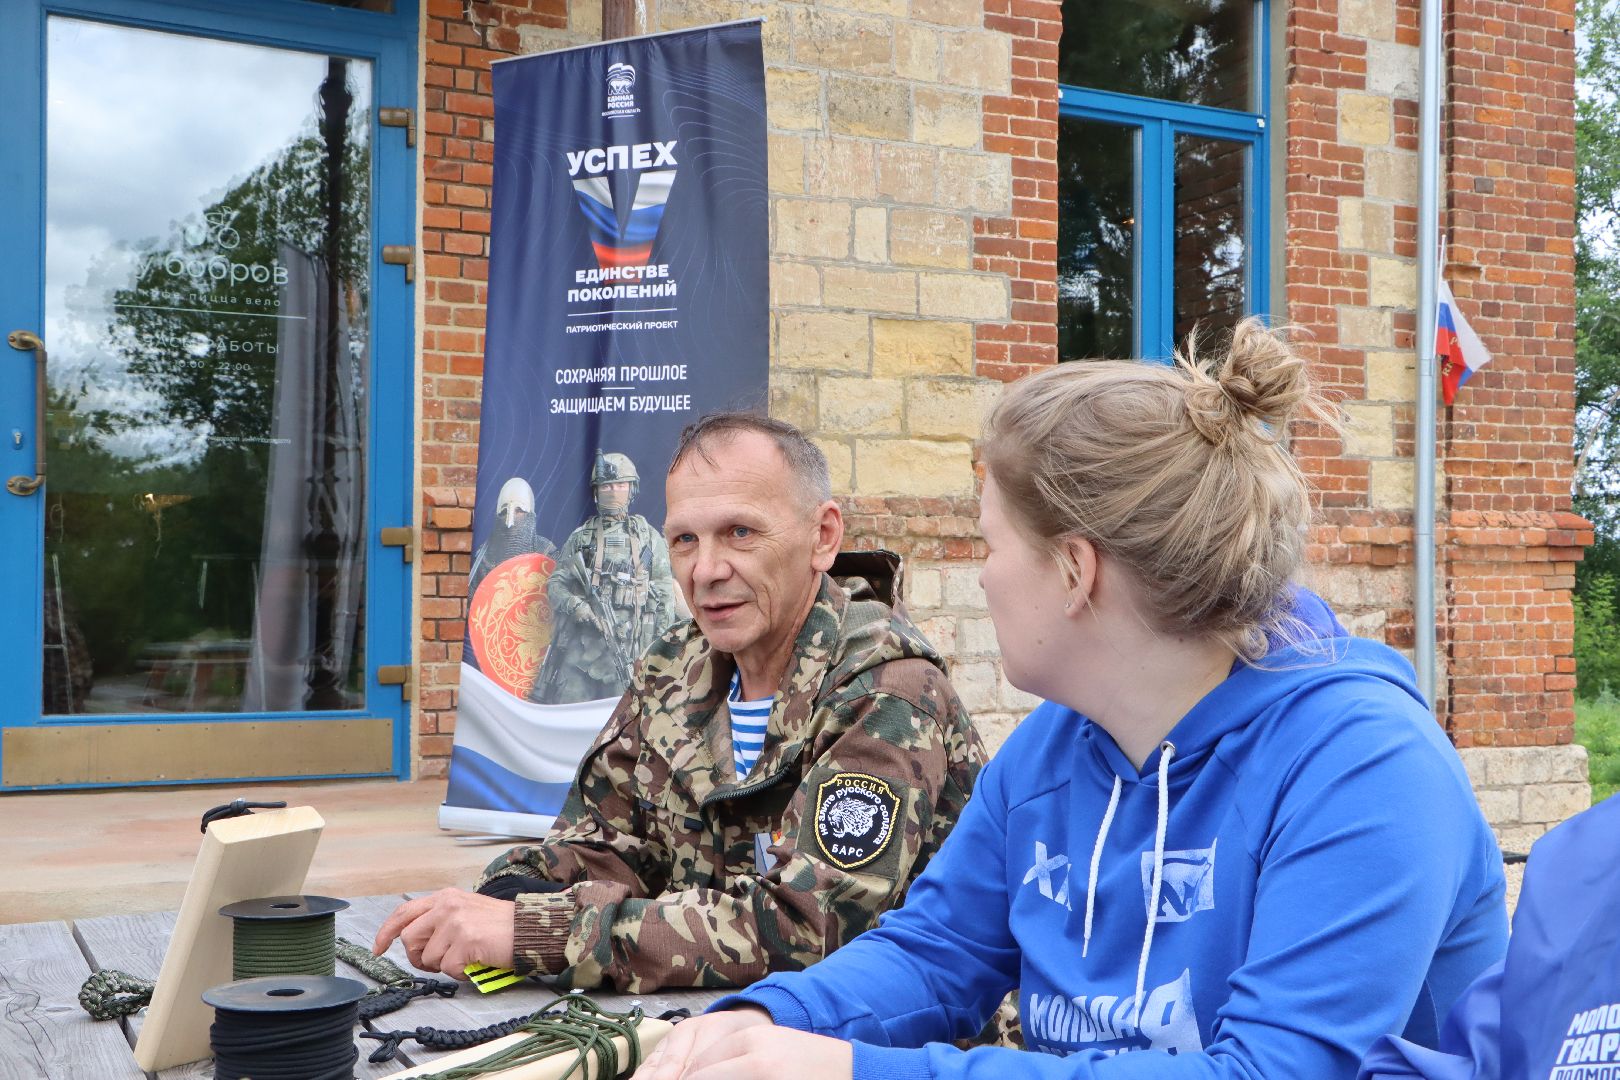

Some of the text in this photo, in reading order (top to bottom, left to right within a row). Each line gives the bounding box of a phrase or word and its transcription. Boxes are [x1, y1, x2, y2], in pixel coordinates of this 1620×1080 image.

[607, 101, 634, 110] РОССИЯ
[566, 140, 678, 176] УСПЕХ
[165, 253, 289, 287] бобров
[575, 264, 669, 284] ЕДИНСТВЕ
[190, 293, 237, 304] пицца
[246, 297, 281, 307] вело
[567, 280, 677, 303] ПОКОЛЕНИЙ
[566, 320, 679, 334] ПАТРИОТИЧЕСКИЙ ПРОЕКТ
[218, 361, 251, 372] 22:00
[555, 364, 688, 385] СОХРАНЯЯ ПРОШЛОЕ
[550, 394, 691, 415] ЗАЩИЩАЕМ БУДУЩЕЕ
[836, 779, 885, 795] РОССИЯ
[818, 823, 829, 836] не
[835, 786, 882, 805] русского
[872, 804, 890, 845] солдата
[831, 843, 864, 858] БАРС
